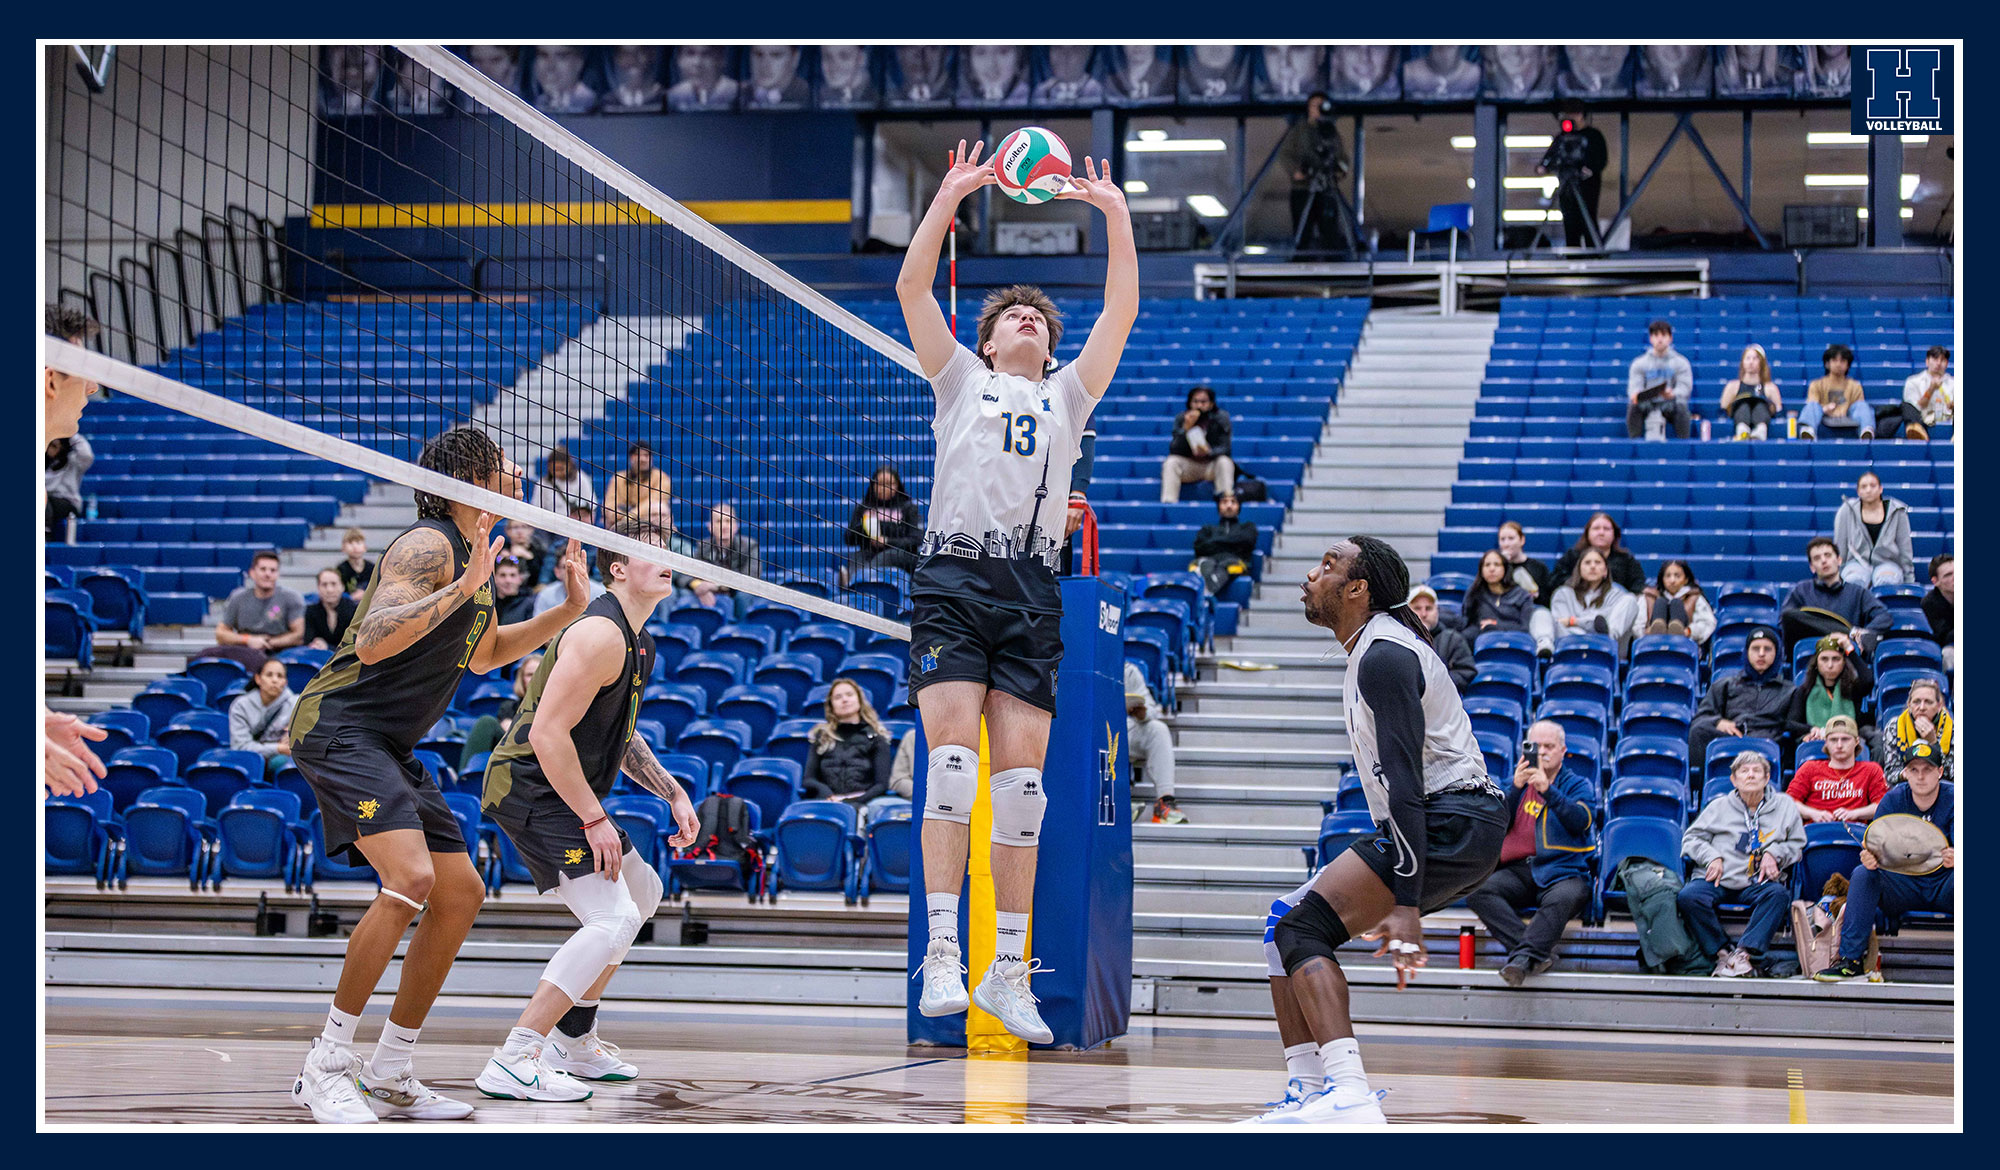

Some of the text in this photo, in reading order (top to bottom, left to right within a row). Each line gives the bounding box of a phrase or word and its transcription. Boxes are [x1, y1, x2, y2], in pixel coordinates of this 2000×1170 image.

[1004, 142, 1028, 171] molten
[1000, 411, 1038, 457] 13
[457, 611, 487, 669] 9
